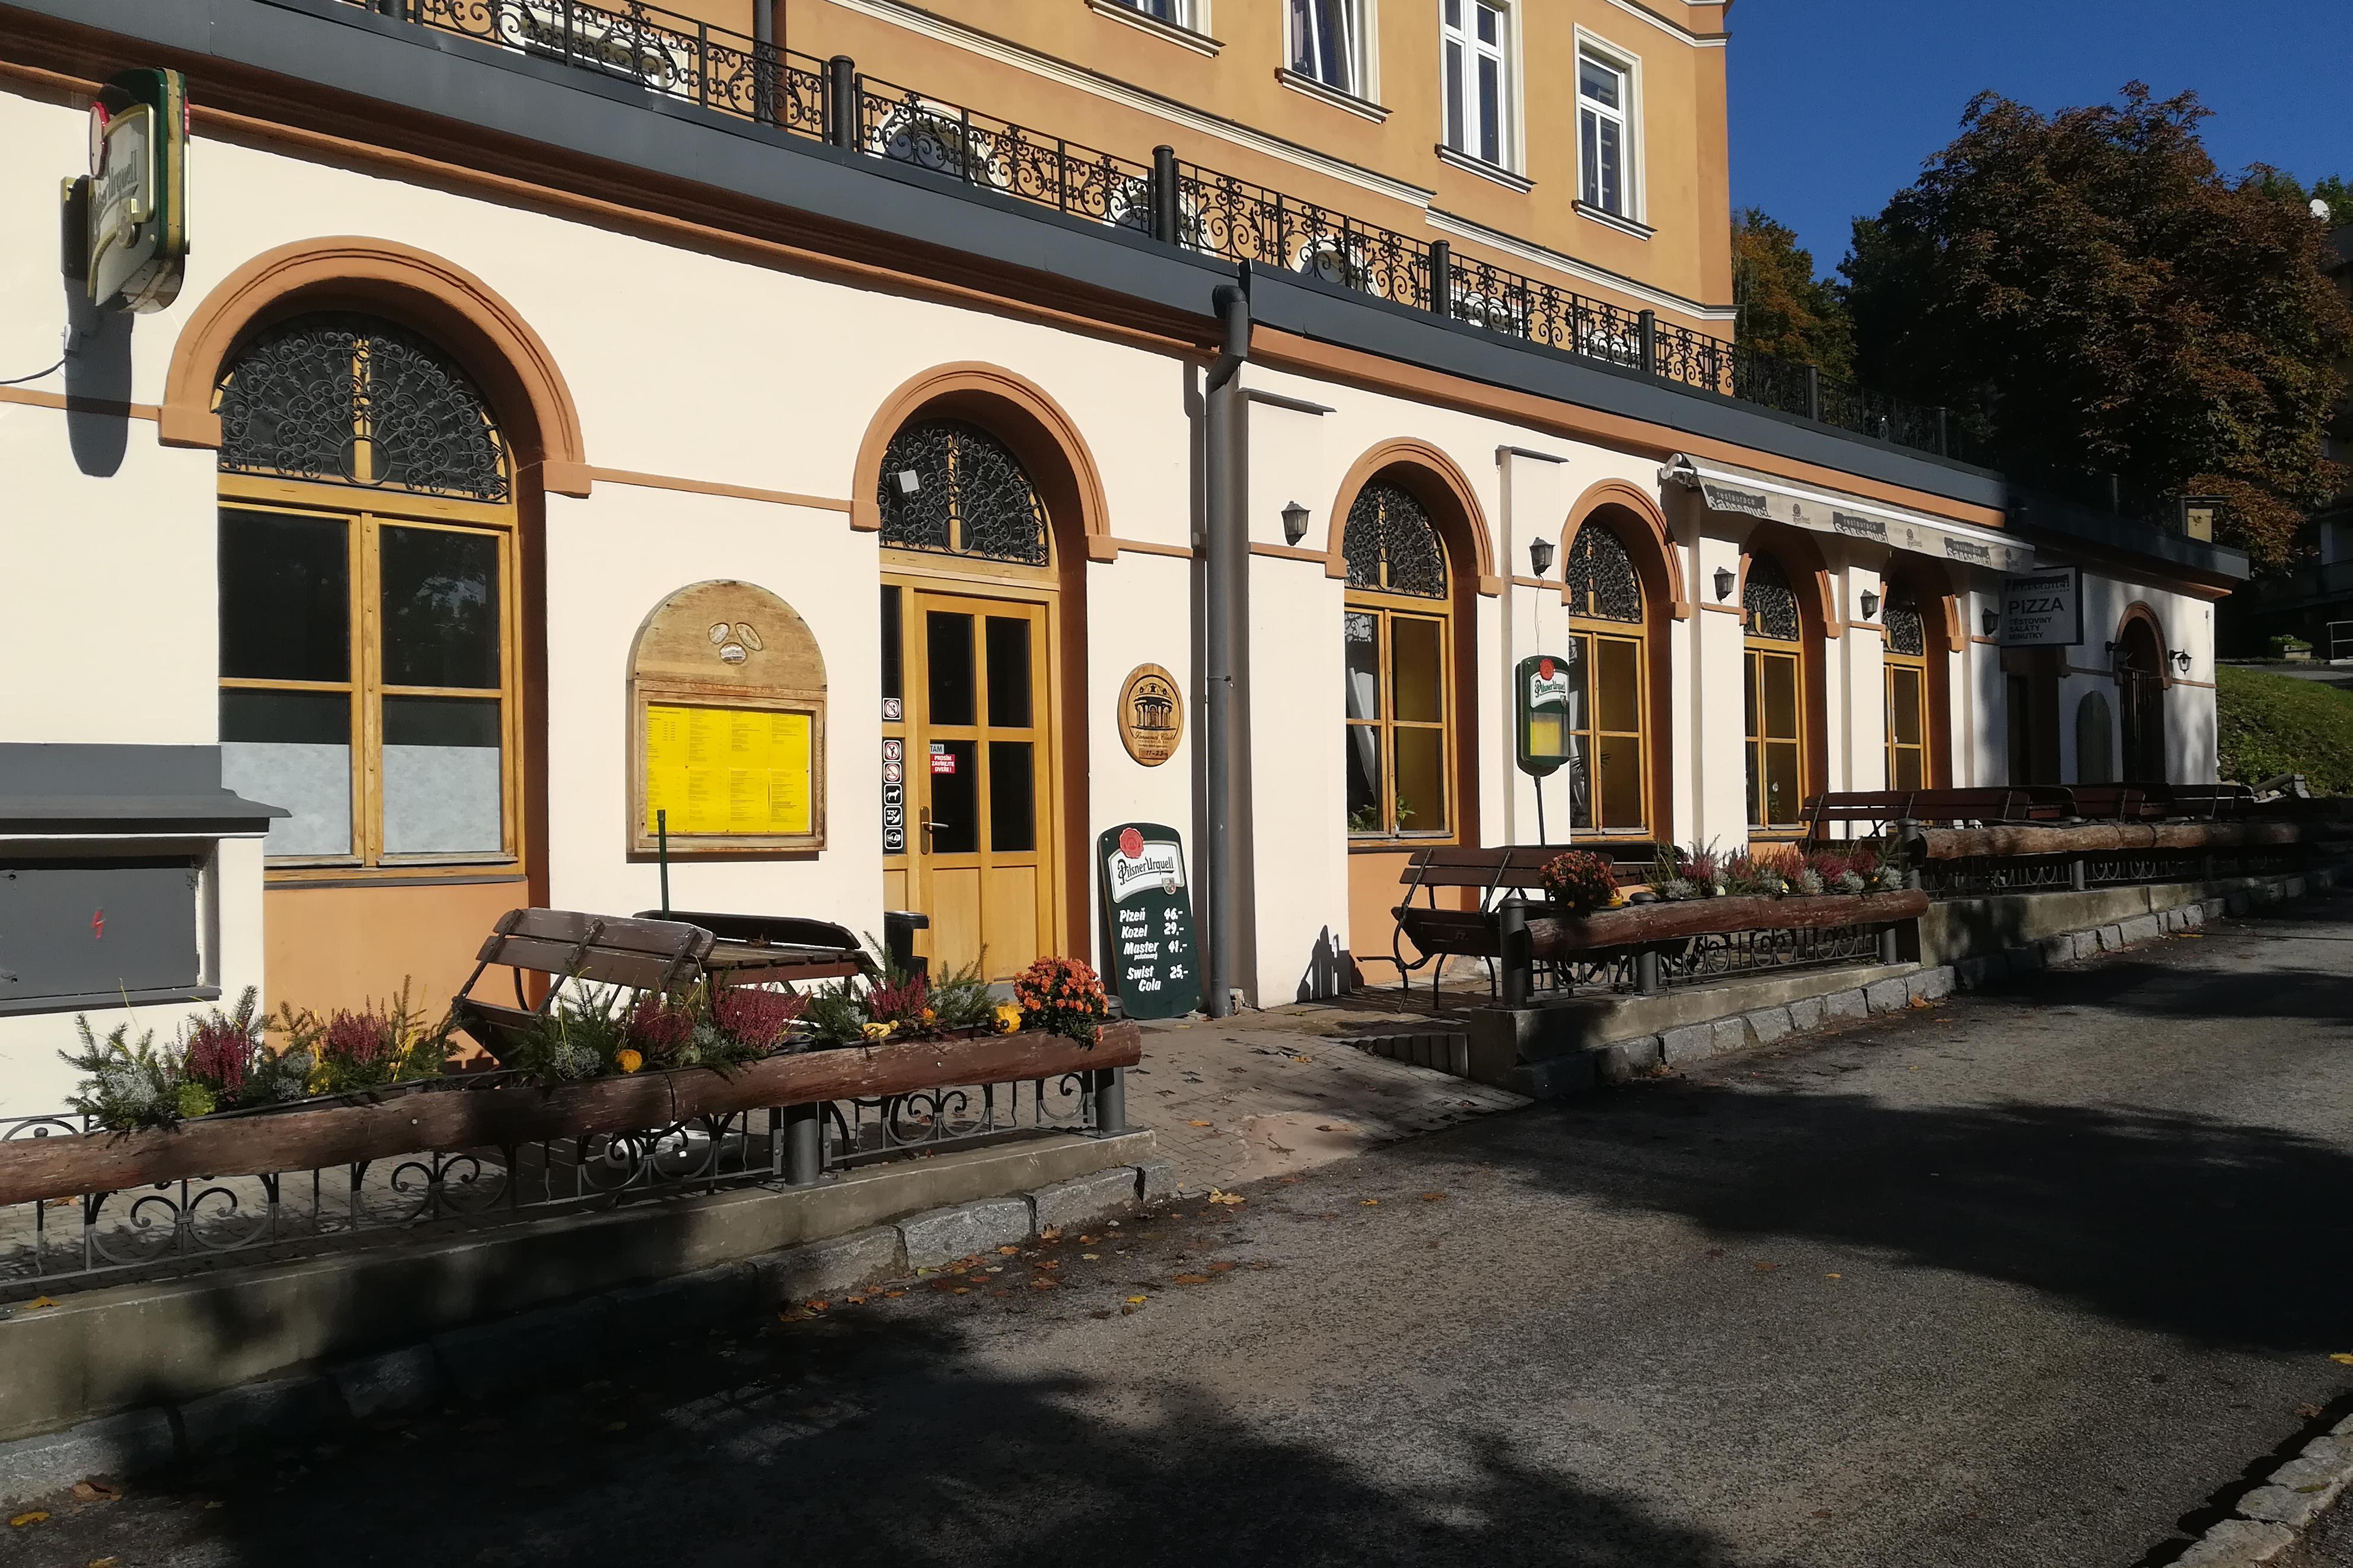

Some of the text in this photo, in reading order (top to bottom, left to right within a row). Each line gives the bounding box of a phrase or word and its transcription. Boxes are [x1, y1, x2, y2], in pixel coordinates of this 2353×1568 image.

[1717, 491, 1755, 505] restaurace
[1843, 518, 1877, 531] restaurace
[2008, 597, 2065, 615] PIZZA
[2008, 632, 2045, 640] MINUTKY
[1535, 679, 1553, 698] Pilsner
[1117, 856, 1174, 886] Pilsner Urquell
[1119, 907, 1146, 922] Plzeň
[1121, 924, 1148, 939] Kozel
[1123, 941, 1159, 955] Master
[1126, 965, 1155, 980] Swist
[1138, 978, 1162, 992] Cola
